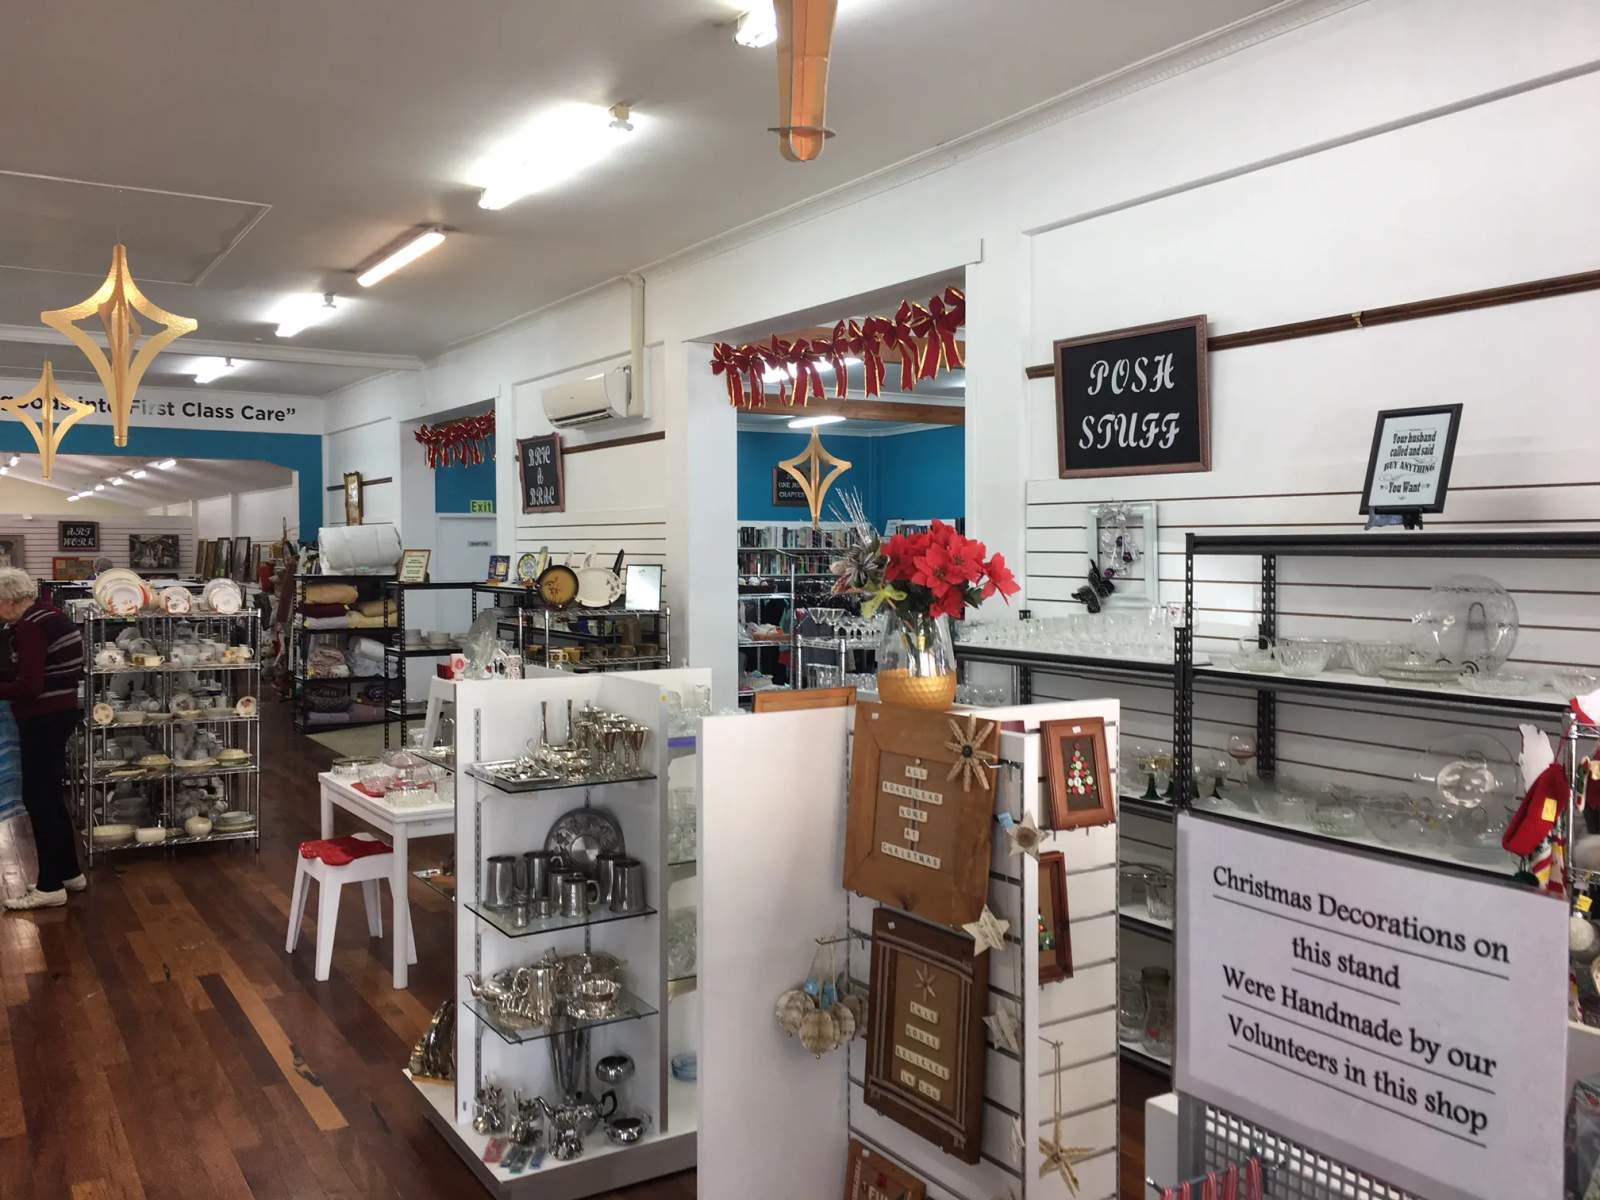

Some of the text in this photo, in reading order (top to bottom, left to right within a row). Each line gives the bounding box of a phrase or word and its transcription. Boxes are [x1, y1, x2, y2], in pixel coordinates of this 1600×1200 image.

[1088, 353, 1175, 396] POSH
[130, 400, 175, 416] First
[182, 402, 234, 419] Class
[241, 405, 296, 421] Care”
[1079, 412, 1180, 449] STUFF
[1393, 431, 1437, 444] Your husband
[1390, 444, 1435, 457] called and said
[1383, 461, 1436, 474] BUY ANYTHING
[1389, 481, 1421, 493] You Want
[471, 501, 492, 513] Exit
[1213, 866, 1510, 964] Christmas Decorations on
[1292, 937, 1400, 990] this stand
[1223, 964, 1497, 1078] Were Handmade by our
[1228, 1013, 1488, 1136] Volunteers in this shop
